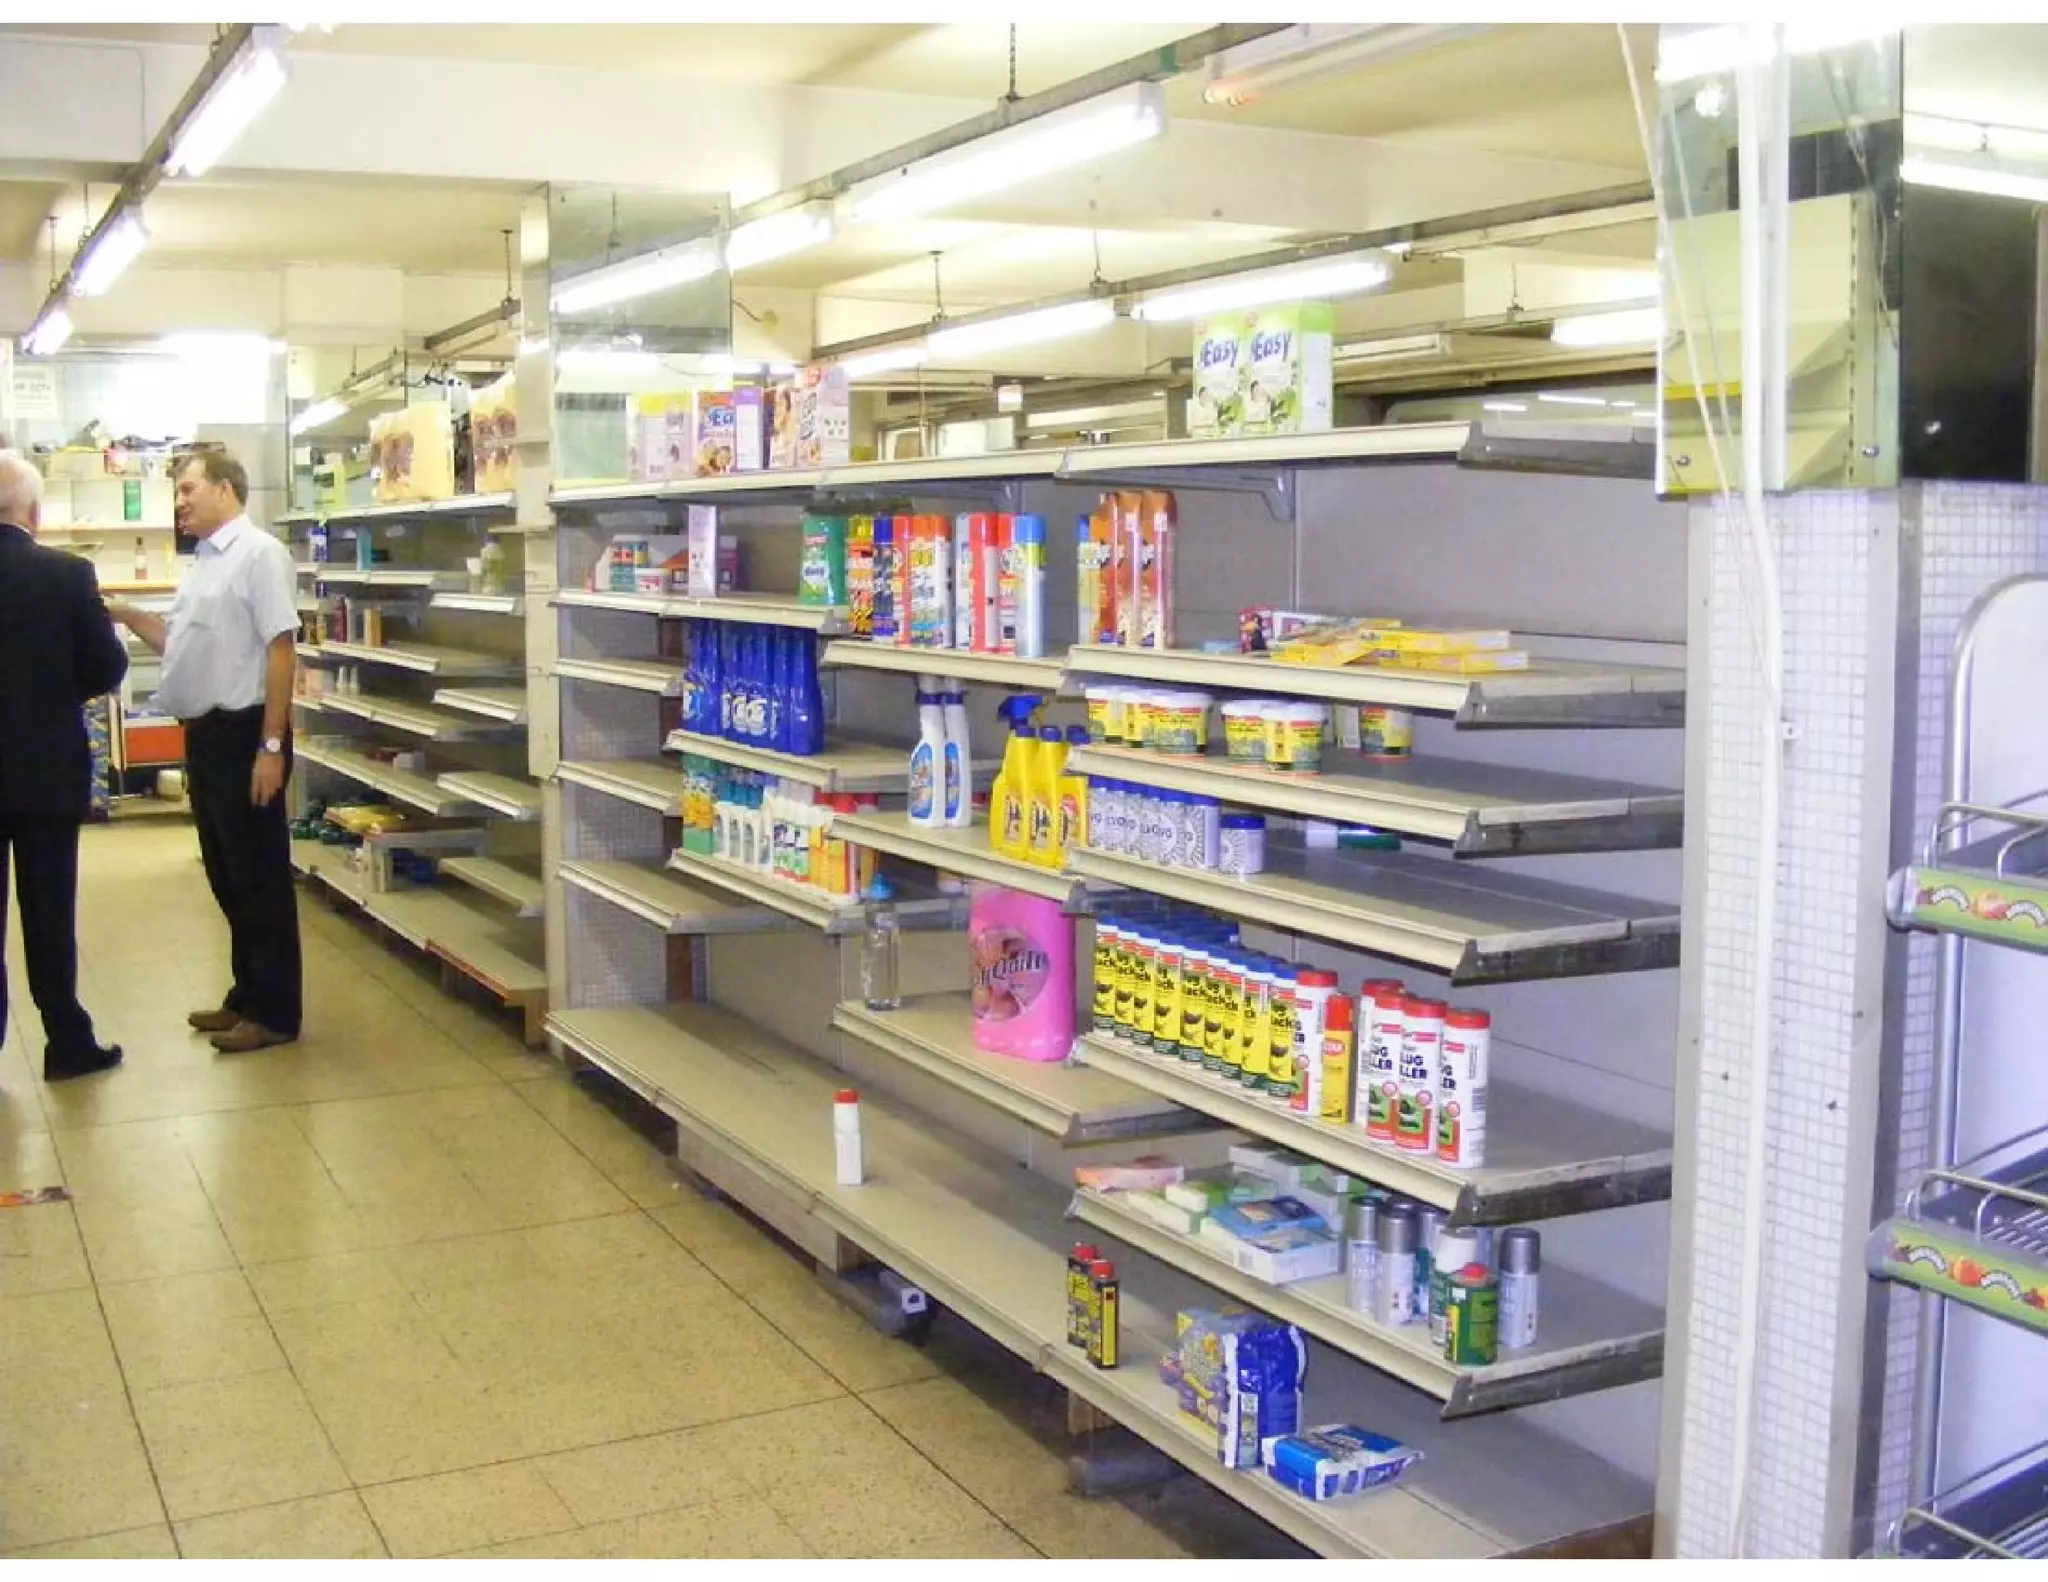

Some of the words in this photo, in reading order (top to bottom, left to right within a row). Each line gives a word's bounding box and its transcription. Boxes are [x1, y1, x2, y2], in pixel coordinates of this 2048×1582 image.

[1203, 337, 1239, 367] Easy
[1254, 331, 1291, 363] Easy
[1400, 1053, 1424, 1067] LUG
